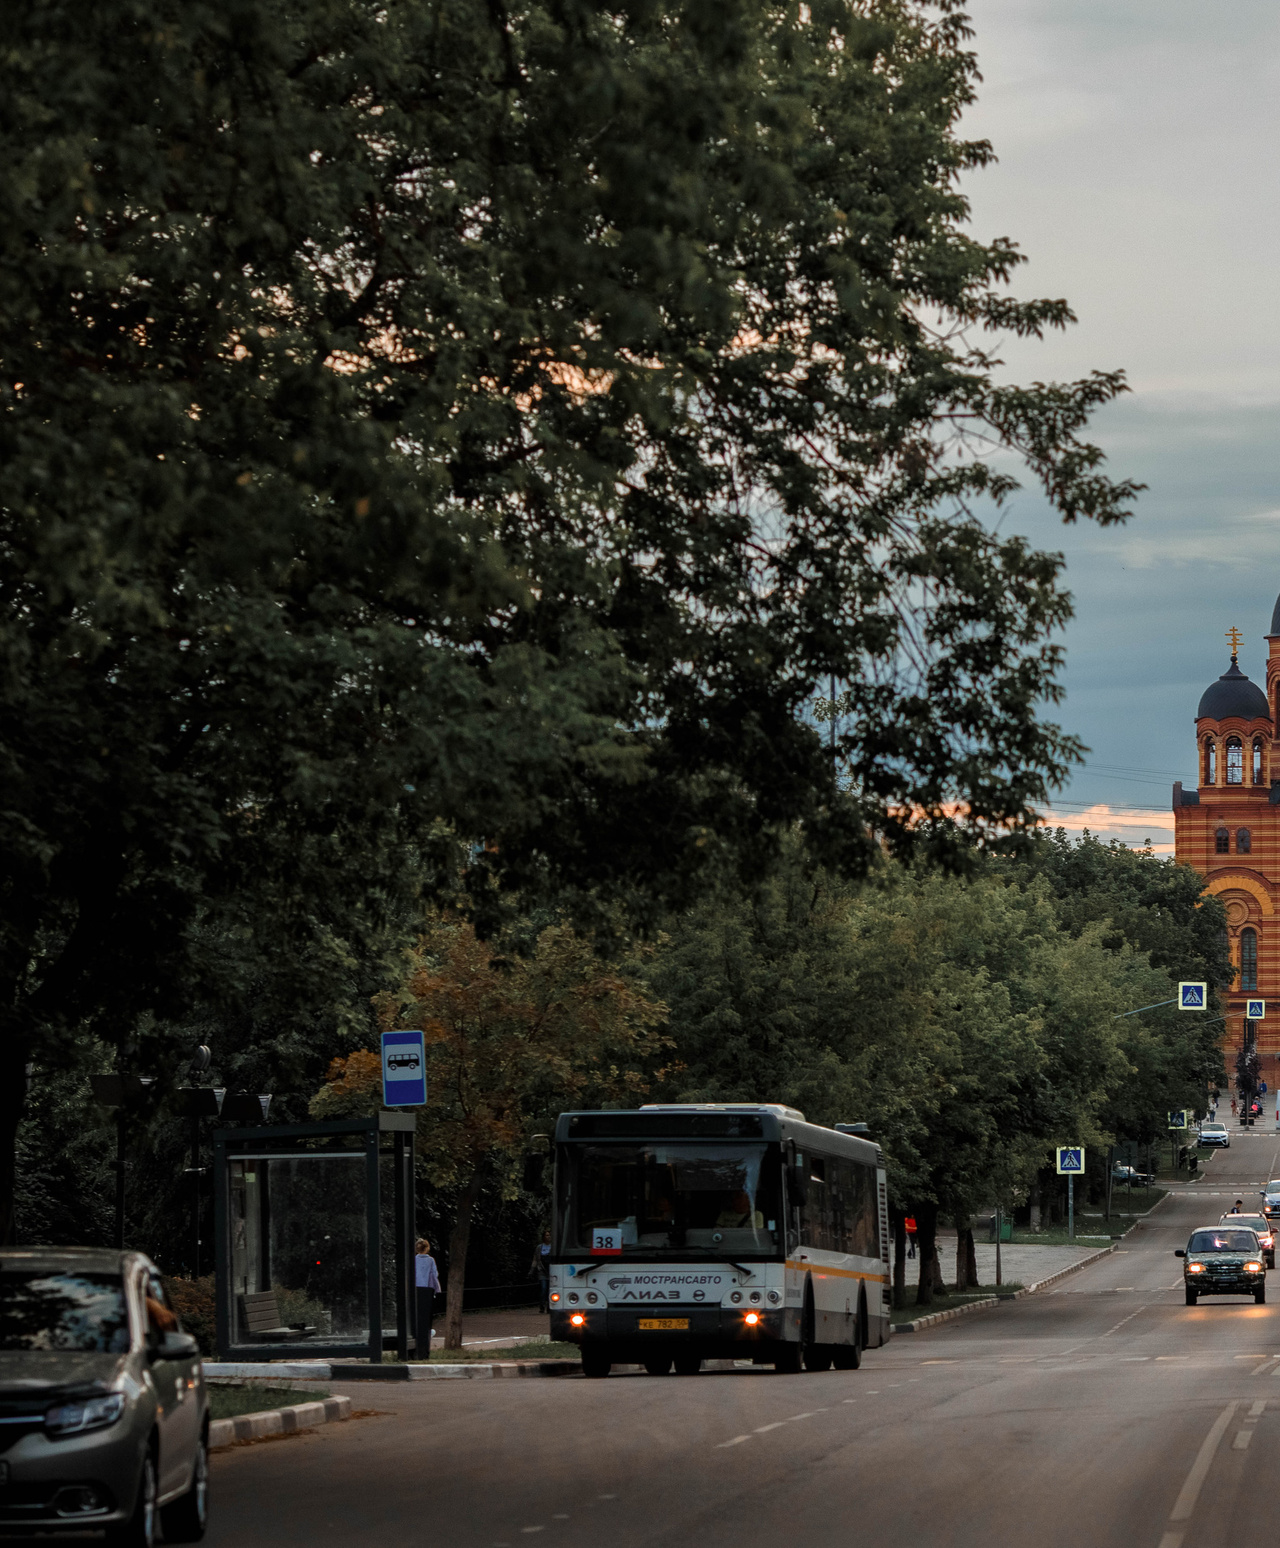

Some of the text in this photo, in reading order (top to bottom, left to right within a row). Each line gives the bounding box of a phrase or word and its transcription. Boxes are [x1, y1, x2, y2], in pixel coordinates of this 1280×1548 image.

[595, 1236, 613, 1249] 38
[633, 1275, 722, 1285] МОСТРАНСАВТО
[622, 1290, 681, 1300] ЛИАЗ
[657, 1320, 673, 1329] 782
